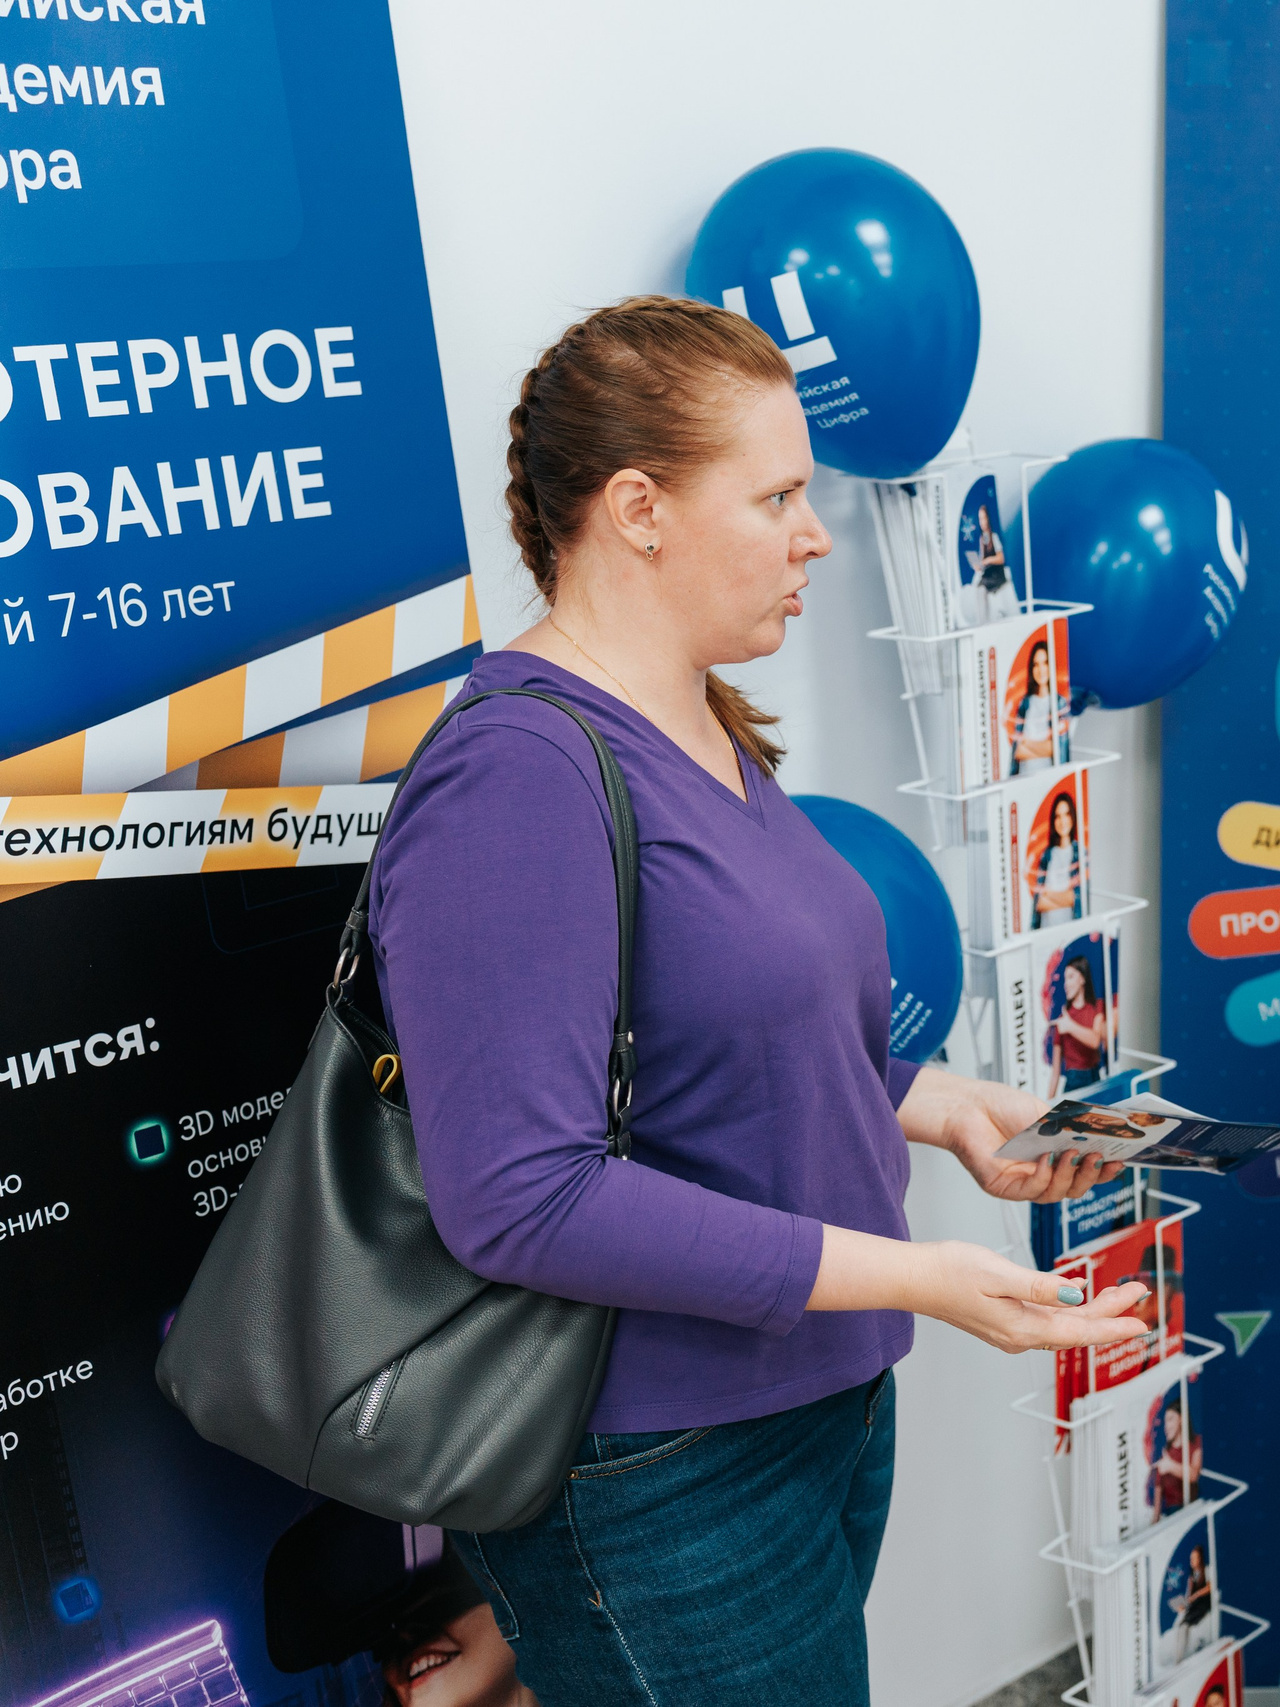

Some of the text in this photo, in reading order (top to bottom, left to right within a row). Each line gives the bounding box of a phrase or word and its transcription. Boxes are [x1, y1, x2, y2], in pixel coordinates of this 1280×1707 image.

[0, 149, 82, 204] ра
[0, 326, 363, 422] ТЕРНОЕ
[816, 407, 870, 429] Цифра
[2, 580, 236, 646] й 7-16 лет
[0, 817, 255, 857] ехнологиям
[178, 1087, 292, 1141] 3D моде
[187, 1136, 267, 1178] основ
[193, 1183, 244, 1217] 3D-
